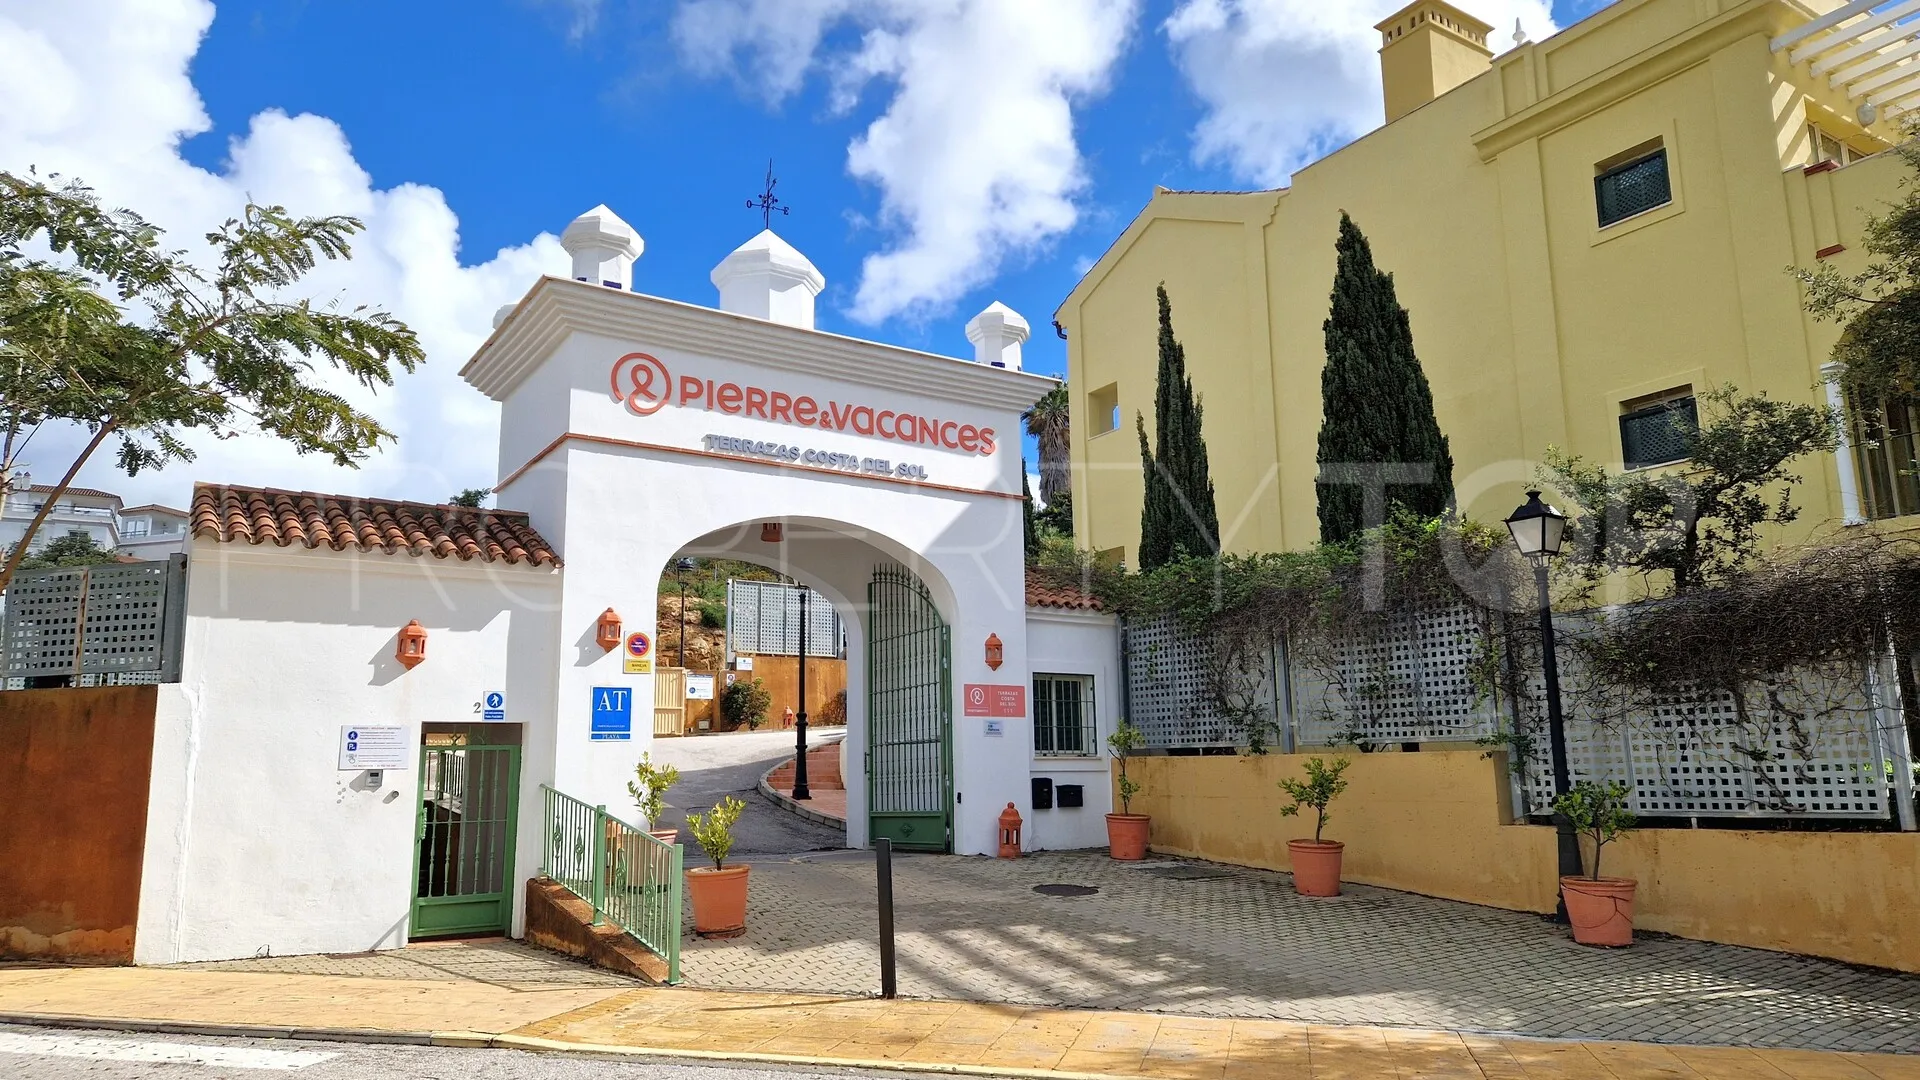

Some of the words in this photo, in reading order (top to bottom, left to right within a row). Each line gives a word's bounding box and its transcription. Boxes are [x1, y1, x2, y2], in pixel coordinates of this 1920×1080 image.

[704, 434, 800, 460] TERRAZAS
[804, 449, 860, 471] COSTA
[864, 458, 894, 474] DEL
[898, 463, 928, 480] SOL
[473, 702, 481, 714] 2
[597, 690, 627, 711] AT
